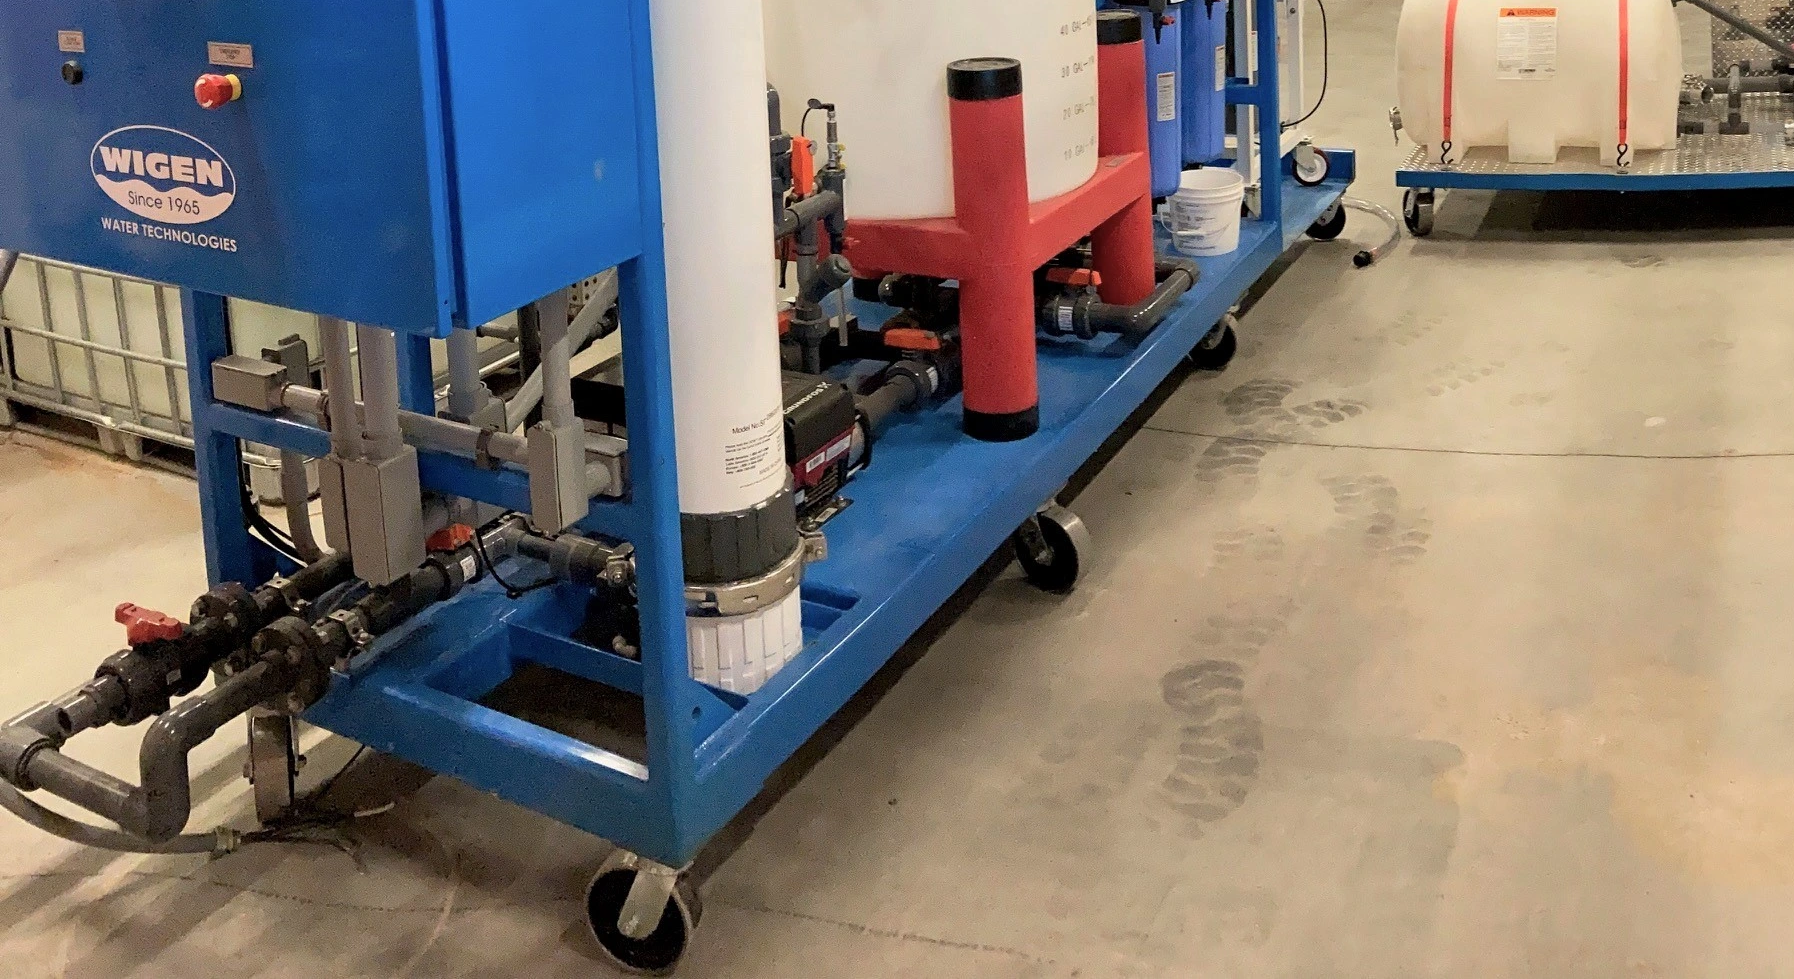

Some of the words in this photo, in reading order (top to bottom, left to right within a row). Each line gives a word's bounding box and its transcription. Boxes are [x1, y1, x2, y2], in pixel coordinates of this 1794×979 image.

[99, 145, 223, 187] WIGEN
[128, 190, 163, 209] Since
[168, 196, 200, 215] 1965
[101, 216, 139, 235] WATER
[142, 223, 237, 253] TECHNOLOGIES
[732, 425, 751, 434] Model
